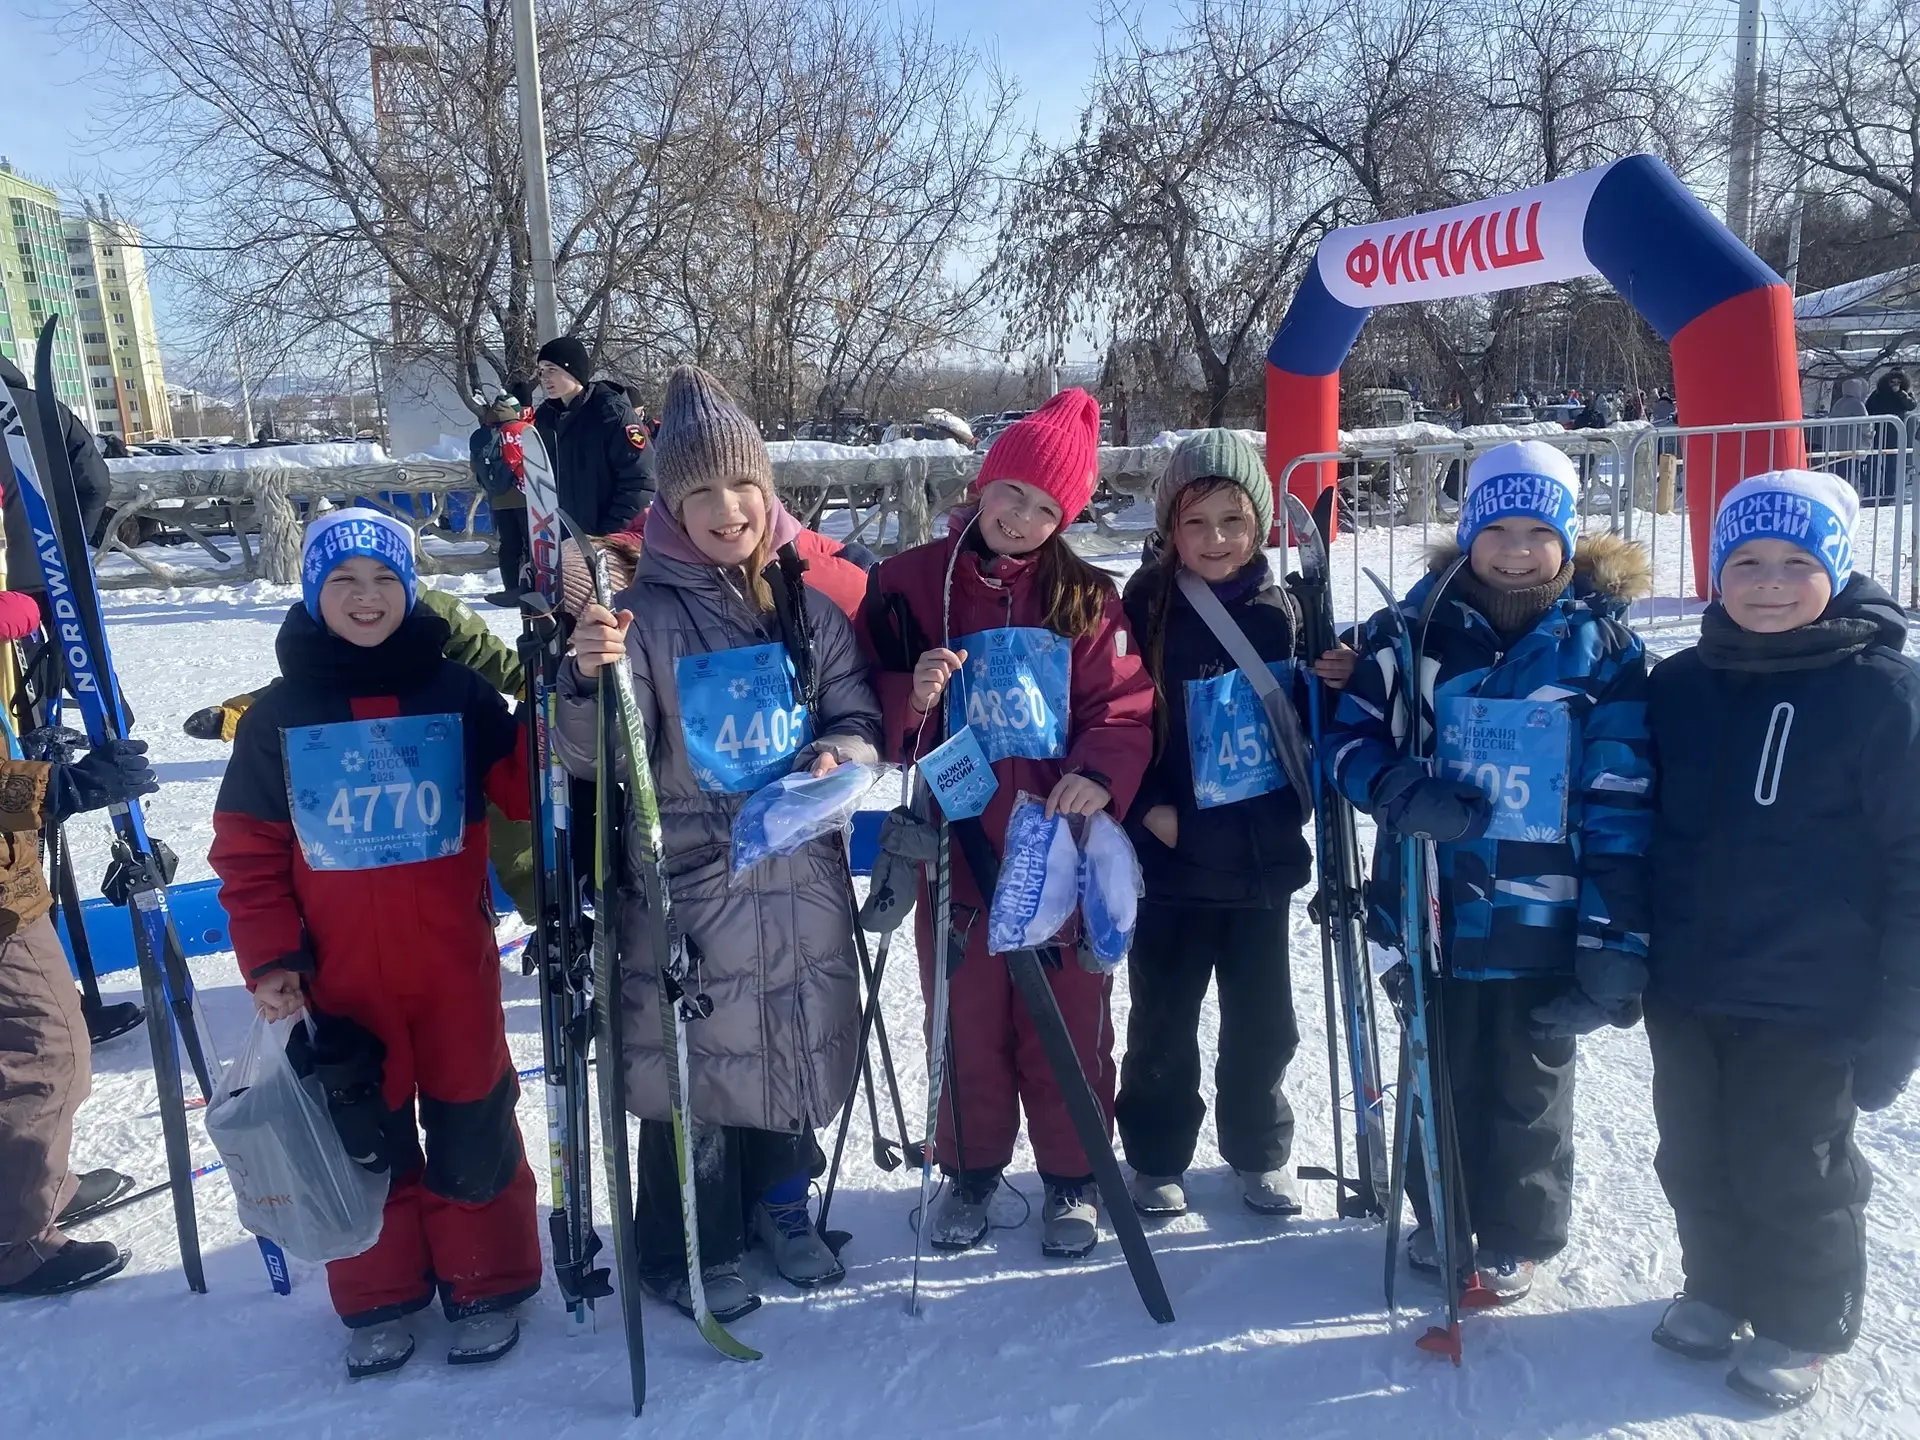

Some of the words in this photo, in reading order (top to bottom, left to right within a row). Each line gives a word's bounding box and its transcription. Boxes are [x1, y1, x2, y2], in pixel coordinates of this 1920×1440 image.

[1344, 201, 1545, 288] ФИНИШ
[1475, 477, 1563, 508] ЛЫЖНЯ
[1475, 492, 1560, 523] РОССИИ
[1719, 494, 1811, 533] ЛЫЖНЯ
[324, 521, 407, 561] ЛЫЖНЯ
[1719, 512, 1810, 551] РОССИИ
[325, 534, 406, 572] РОССИИ
[33, 527, 96, 695] NORDWAY
[753, 673, 787, 687] ЛЫЖ
[753, 683, 788, 697] РОСС
[756, 698, 778, 709] 2026
[968, 687, 1046, 731] 4830
[715, 703, 807, 760] 4405
[1464, 737, 1516, 751] РОССИИ
[1465, 726, 1516, 740] ЛЫЖНЯ
[367, 745, 419, 760] ЛЫЖНЯ
[367, 756, 420, 771] РОССИИ
[1464, 749, 1488, 760] 2026
[370, 771, 395, 783] 2026
[937, 755, 972, 785] ЛЫЖНЯ
[939, 764, 975, 792] РОССИИ
[1436, 758, 1531, 810] 705
[327, 780, 442, 834] 4770
[335, 829, 439, 846] ЧЕЛЯБИНСКАЯ
[353, 841, 422, 852] ОБЛАСТЬ
[1001, 844, 1029, 915] РОССИИ
[1015, 846, 1045, 918] ЛЫЖНЯ
[266, 1254, 285, 1283] 160
